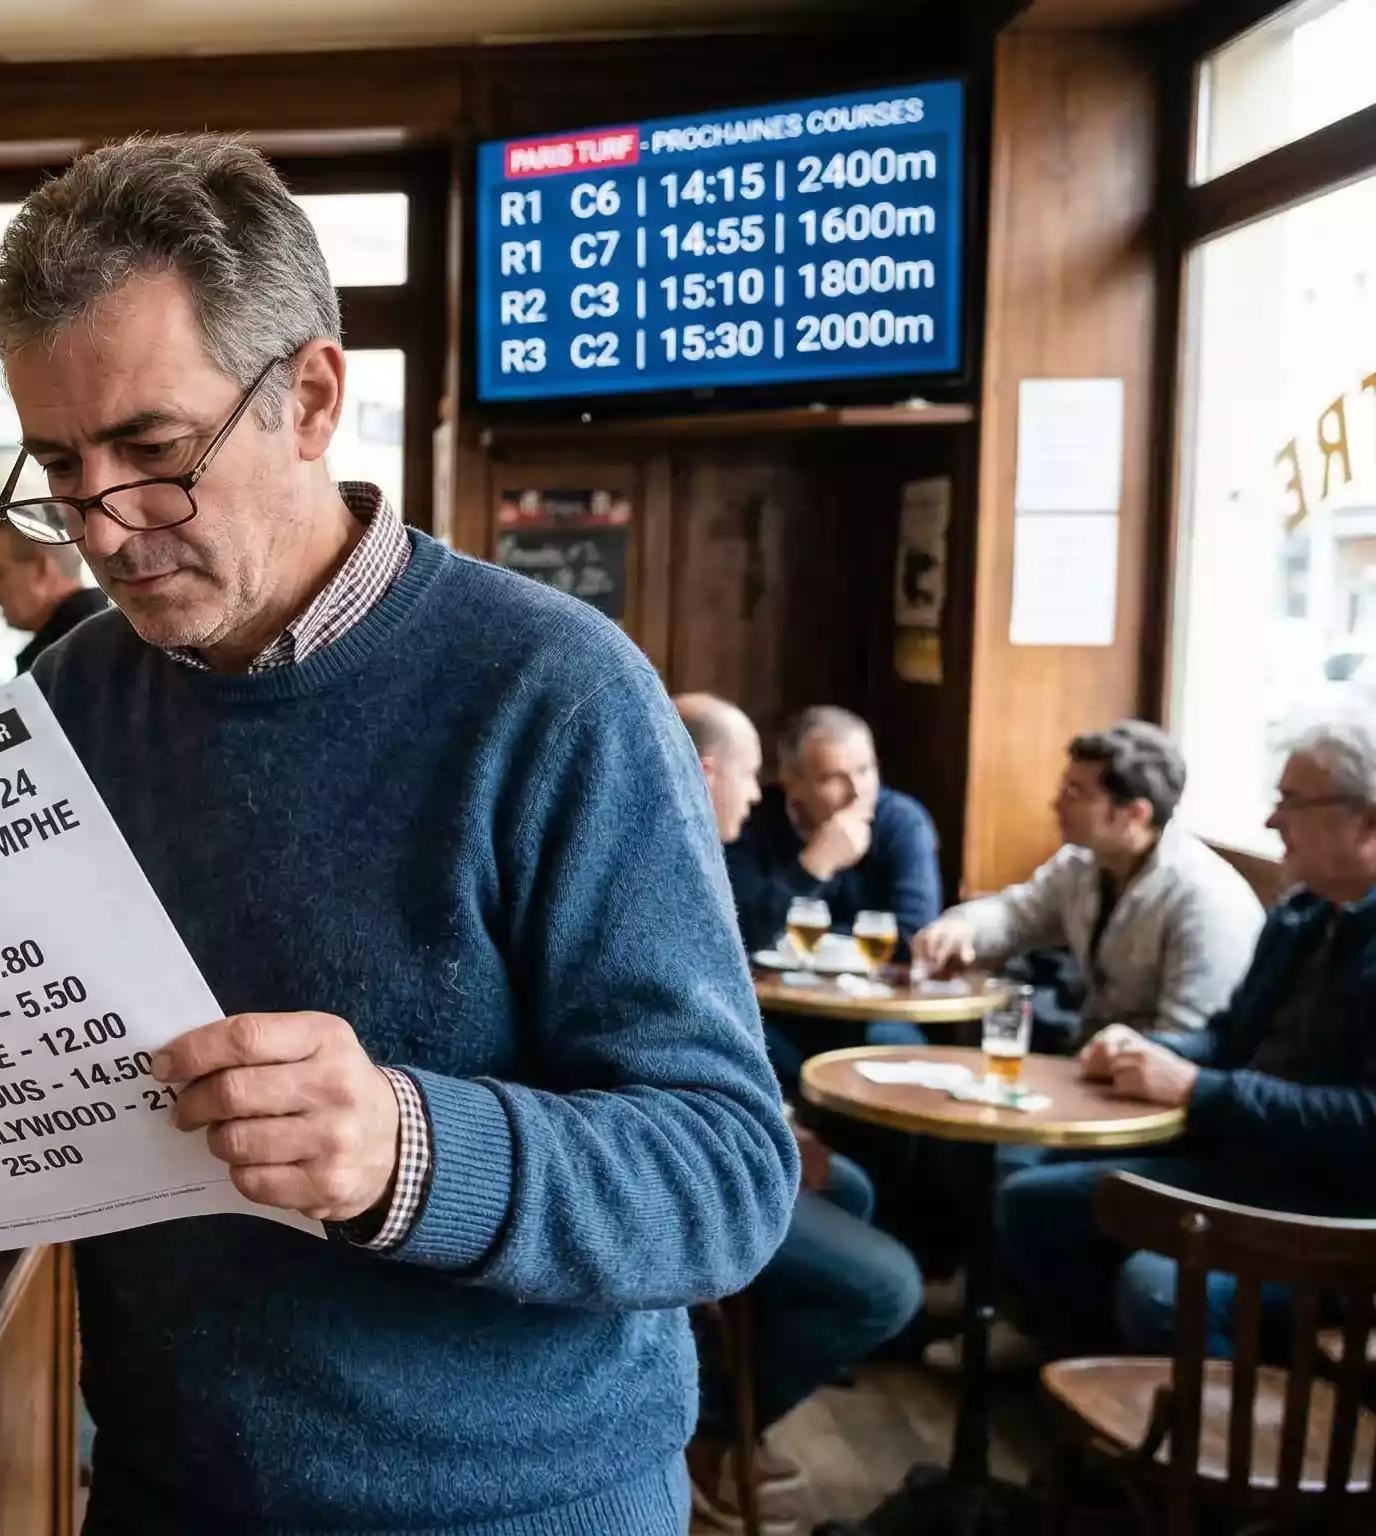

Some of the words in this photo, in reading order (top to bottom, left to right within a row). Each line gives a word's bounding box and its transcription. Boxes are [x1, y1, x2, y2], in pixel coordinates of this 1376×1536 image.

[510, 143, 574, 173] PARIS
[576, 134, 634, 163] TURF
[652, 113, 803, 154] PROCHAINES
[806, 97, 924, 135] COURSES
[501, 191, 542, 227] R1
[570, 180, 621, 218] C6
[637, 177, 646, 217] |
[660, 163, 765, 207] 14:15
[775, 160, 785, 201] |
[797, 147, 936, 194] 2400m
[501, 240, 542, 275] R1
[570, 231, 621, 268] C7
[637, 227, 646, 268] |
[660, 215, 765, 260] 14:55
[775, 212, 785, 254] |
[798, 202, 936, 246] 1600m
[501, 289, 548, 324] R2
[570, 282, 620, 318] C3
[637, 278, 646, 319] |
[660, 269, 765, 310] 15:10
[775, 265, 784, 307] |
[798, 256, 935, 299] 1800m
[501, 338, 547, 373] R3
[570, 332, 620, 369] C2
[636, 330, 645, 370] |
[660, 321, 764, 362] 15:30
[775, 317, 784, 359] |
[796, 309, 934, 352] 2000m
[15, 975, 87, 1018] 5.50
[38, 1012, 127, 1057] 12.00
[69, 1051, 153, 1090] 14.50
[1, 1144, 84, 1177] 25.00
